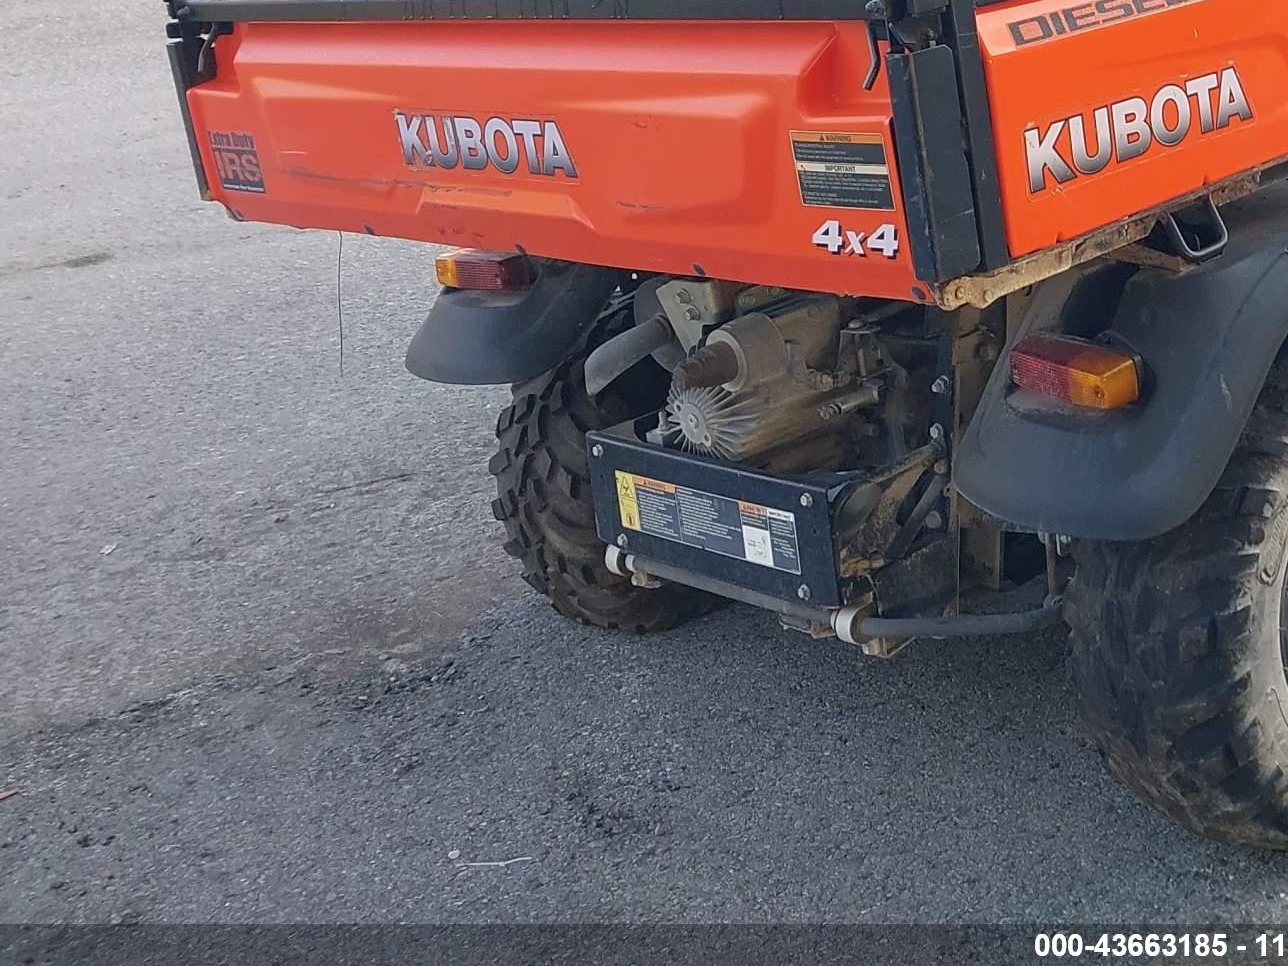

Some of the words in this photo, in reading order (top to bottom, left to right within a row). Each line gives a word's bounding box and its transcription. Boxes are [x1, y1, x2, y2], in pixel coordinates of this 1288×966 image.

[396, 113, 579, 178] KUBOTA
[1022, 65, 1254, 195] KUBOTA
[214, 150, 263, 183] IRS
[824, 164, 857, 173] IMPORTANT
[812, 219, 900, 260] 4x4
